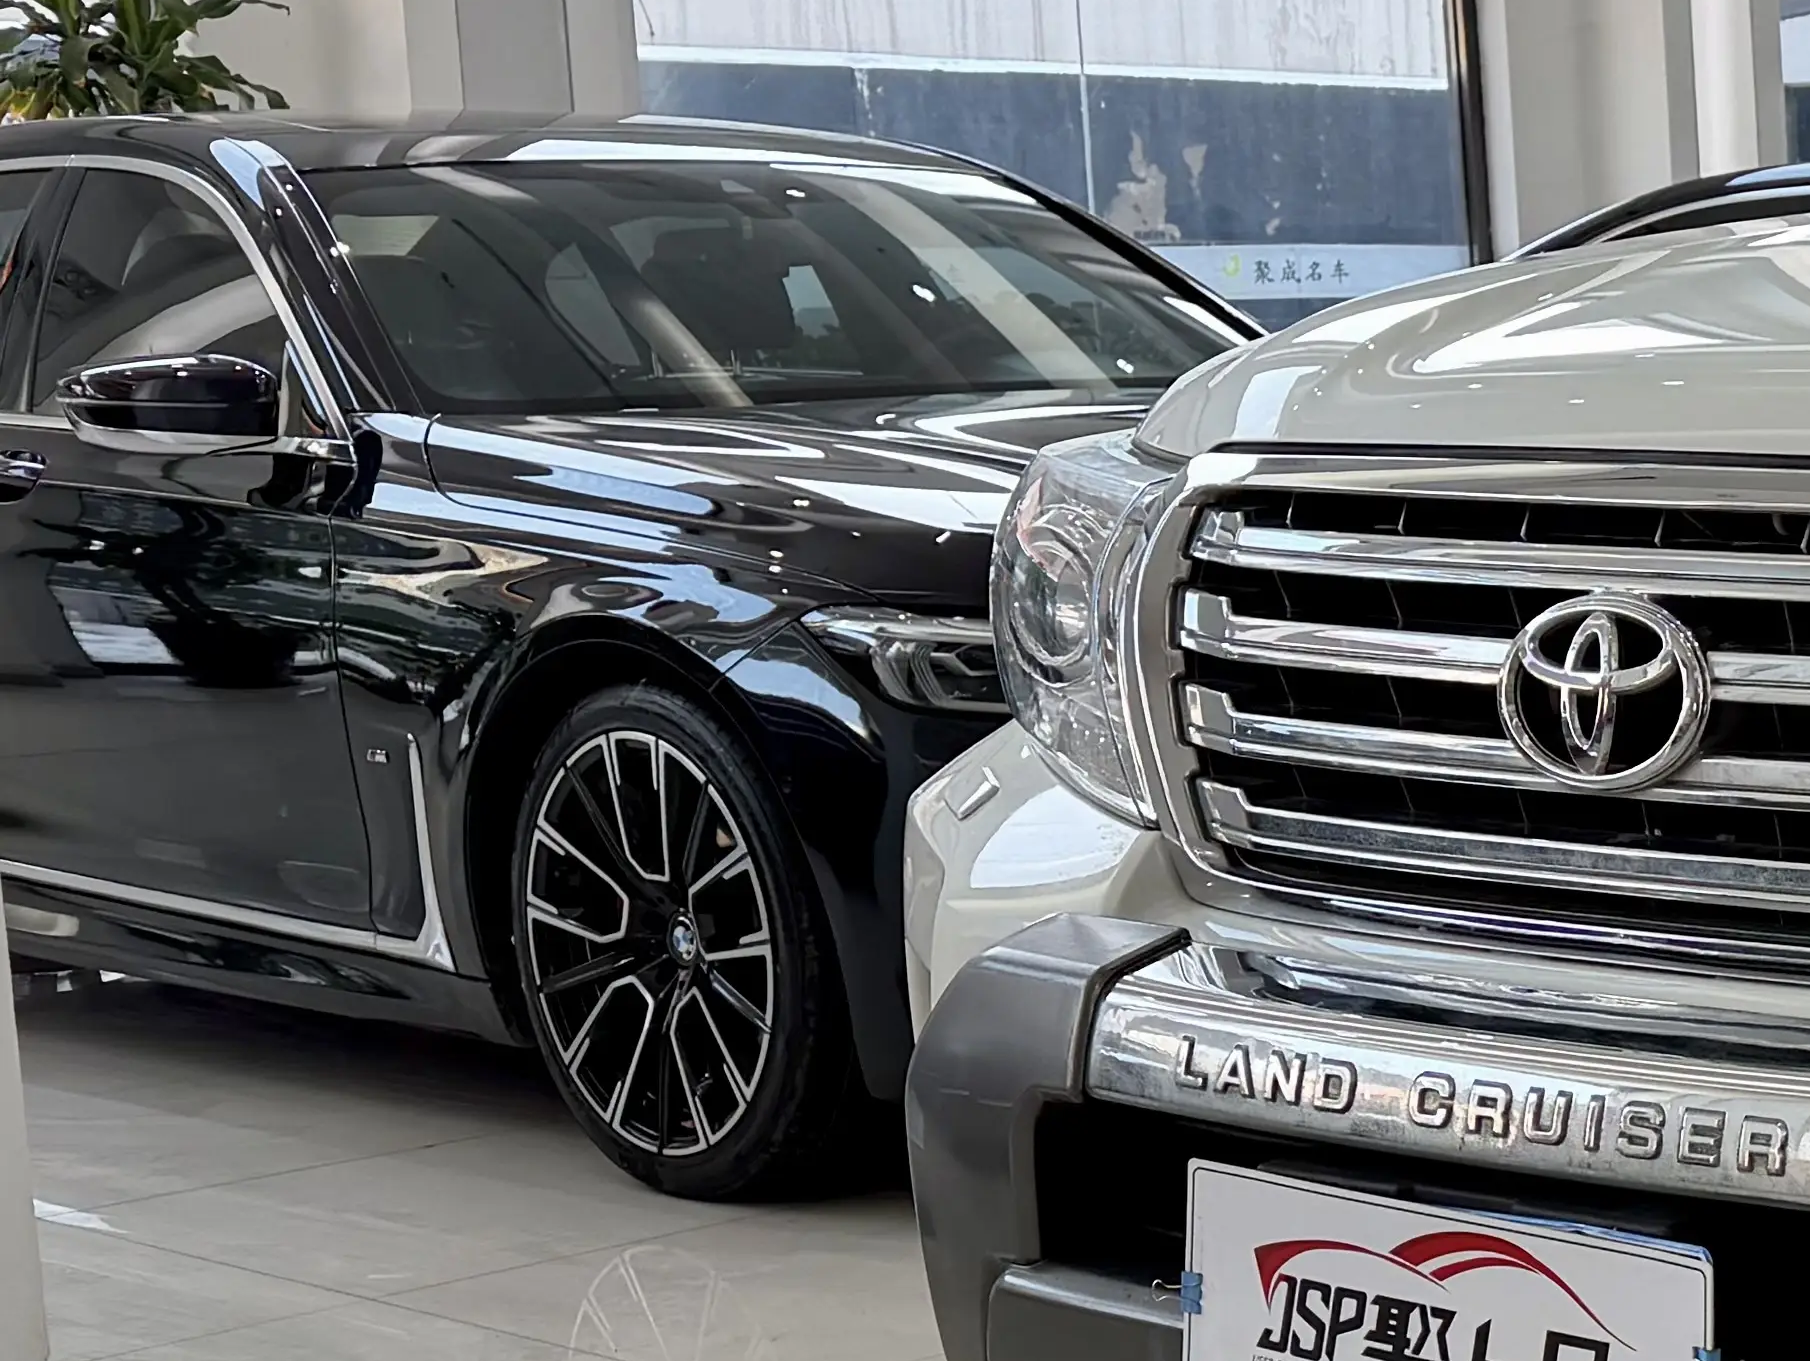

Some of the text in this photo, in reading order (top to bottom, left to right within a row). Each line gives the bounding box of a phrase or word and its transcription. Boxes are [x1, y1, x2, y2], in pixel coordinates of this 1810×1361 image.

[1253, 258, 1350, 285] 聚成名车
[1174, 1035, 1789, 1178] LAND CRUISER
